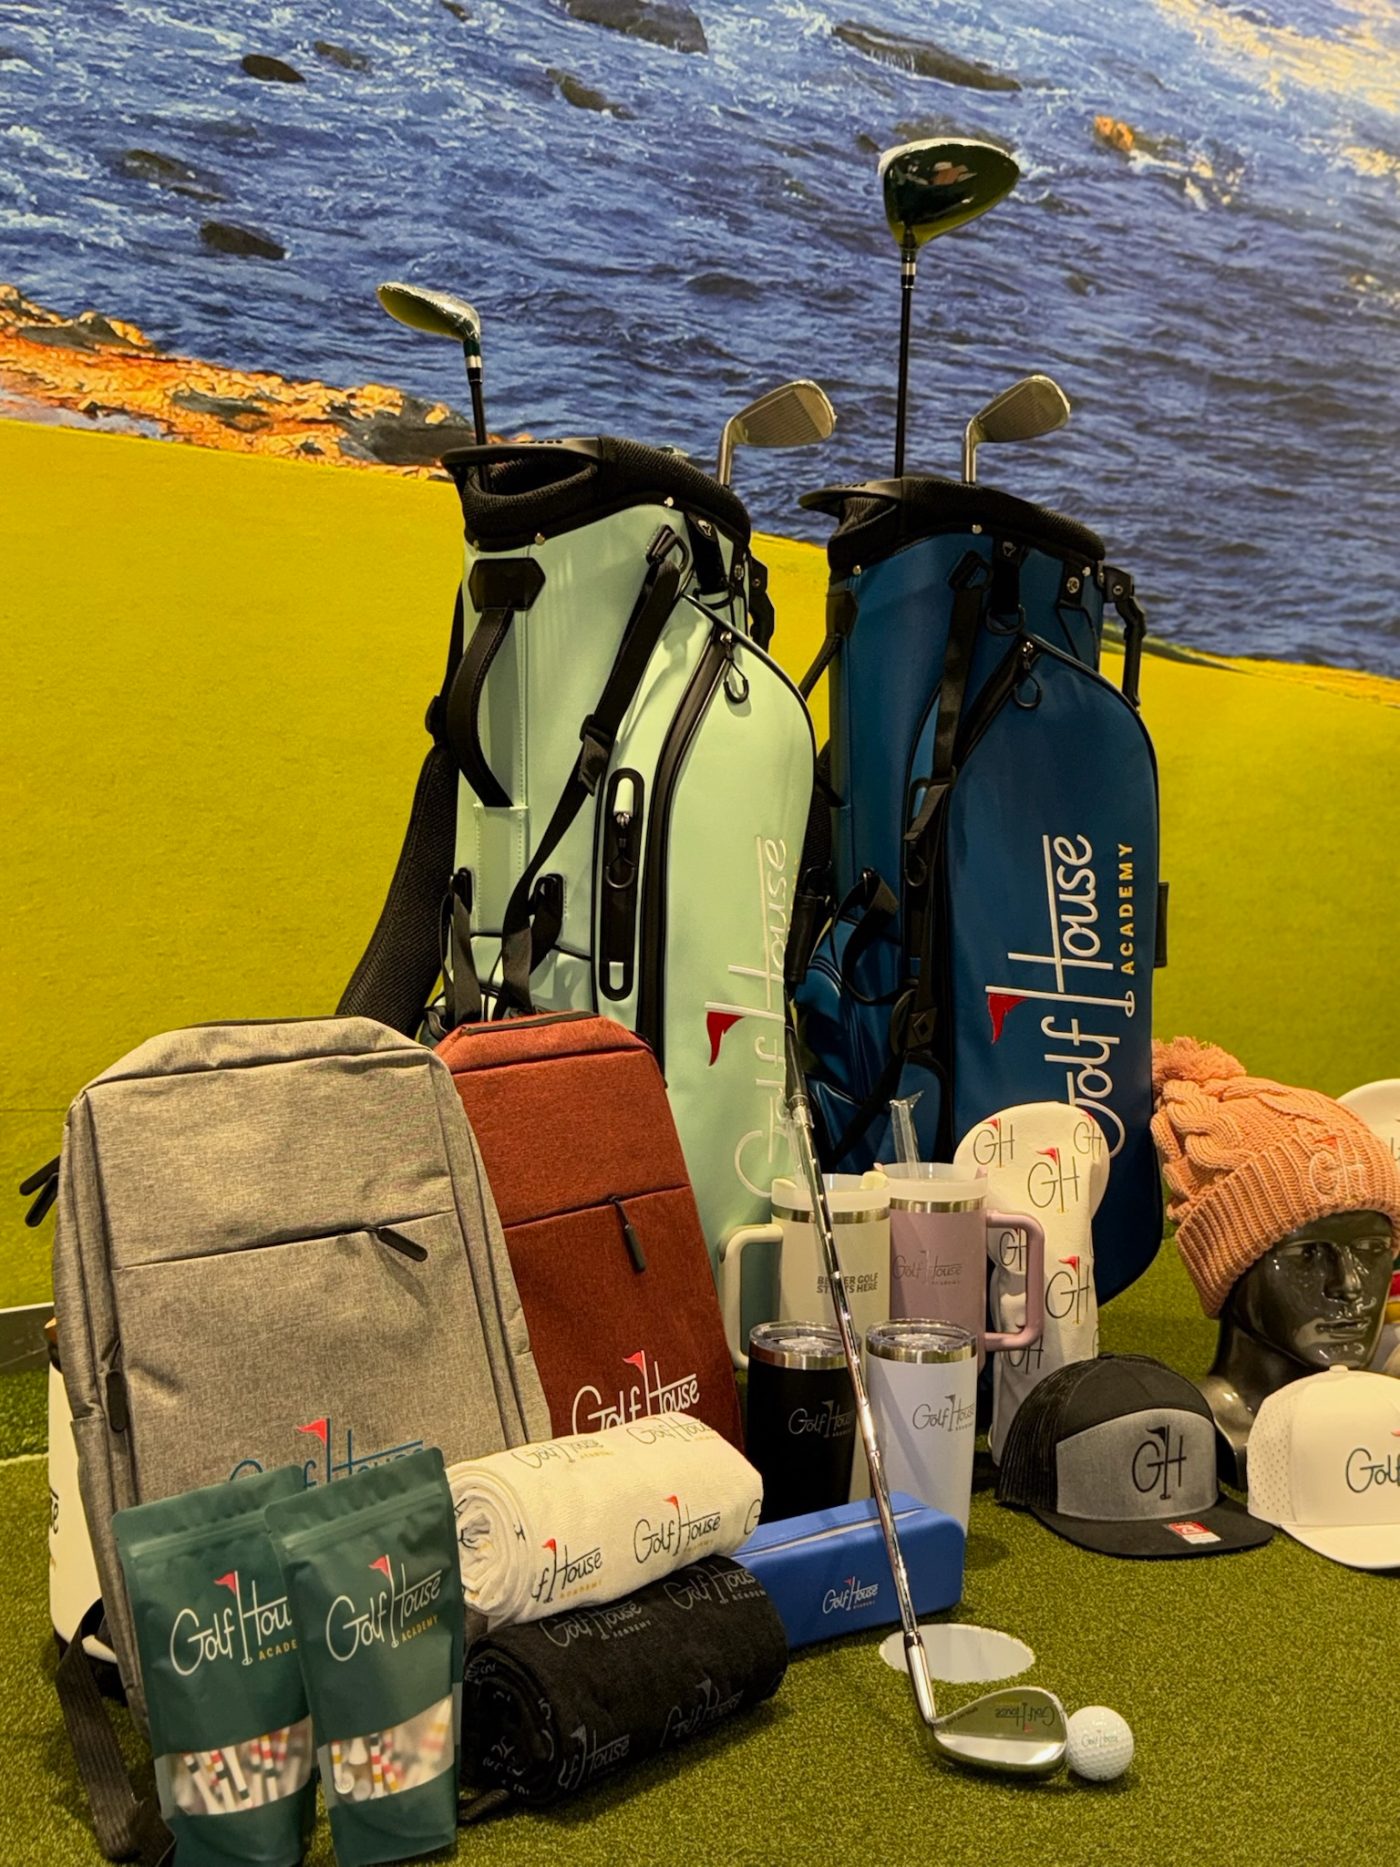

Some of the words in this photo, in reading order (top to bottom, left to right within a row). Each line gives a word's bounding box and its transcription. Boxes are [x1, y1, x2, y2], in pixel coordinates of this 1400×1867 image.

[984, 833, 1135, 1018] House
[1117, 843, 1135, 976] ACADEMY
[973, 1118, 1015, 1168] GH
[1027, 1147, 1080, 1213] GH
[857, 1272, 879, 1284] GOLF
[1045, 1256, 1090, 1324] GH
[640, 1349, 700, 1417] House
[788, 1407, 828, 1435] Golf
[912, 1403, 949, 1430] Golf
[1132, 1424, 1187, 1500] GH
[633, 1518, 677, 1564] Golf
[671, 1496, 721, 1557] House
[549, 1538, 604, 1603] House
[664, 1573, 713, 1611] Golf
[698, 1564, 757, 1604] Hous
[823, 1589, 850, 1614] Golf
[326, 1594, 387, 1662] Golf
[384, 1554, 442, 1648] House
[401, 1614, 439, 1643] ACADEMY
[539, 1609, 593, 1648] Golf
[585, 1600, 642, 1641] House
[170, 1608, 235, 1676] Golf
[258, 1639, 297, 1661] ACADE
